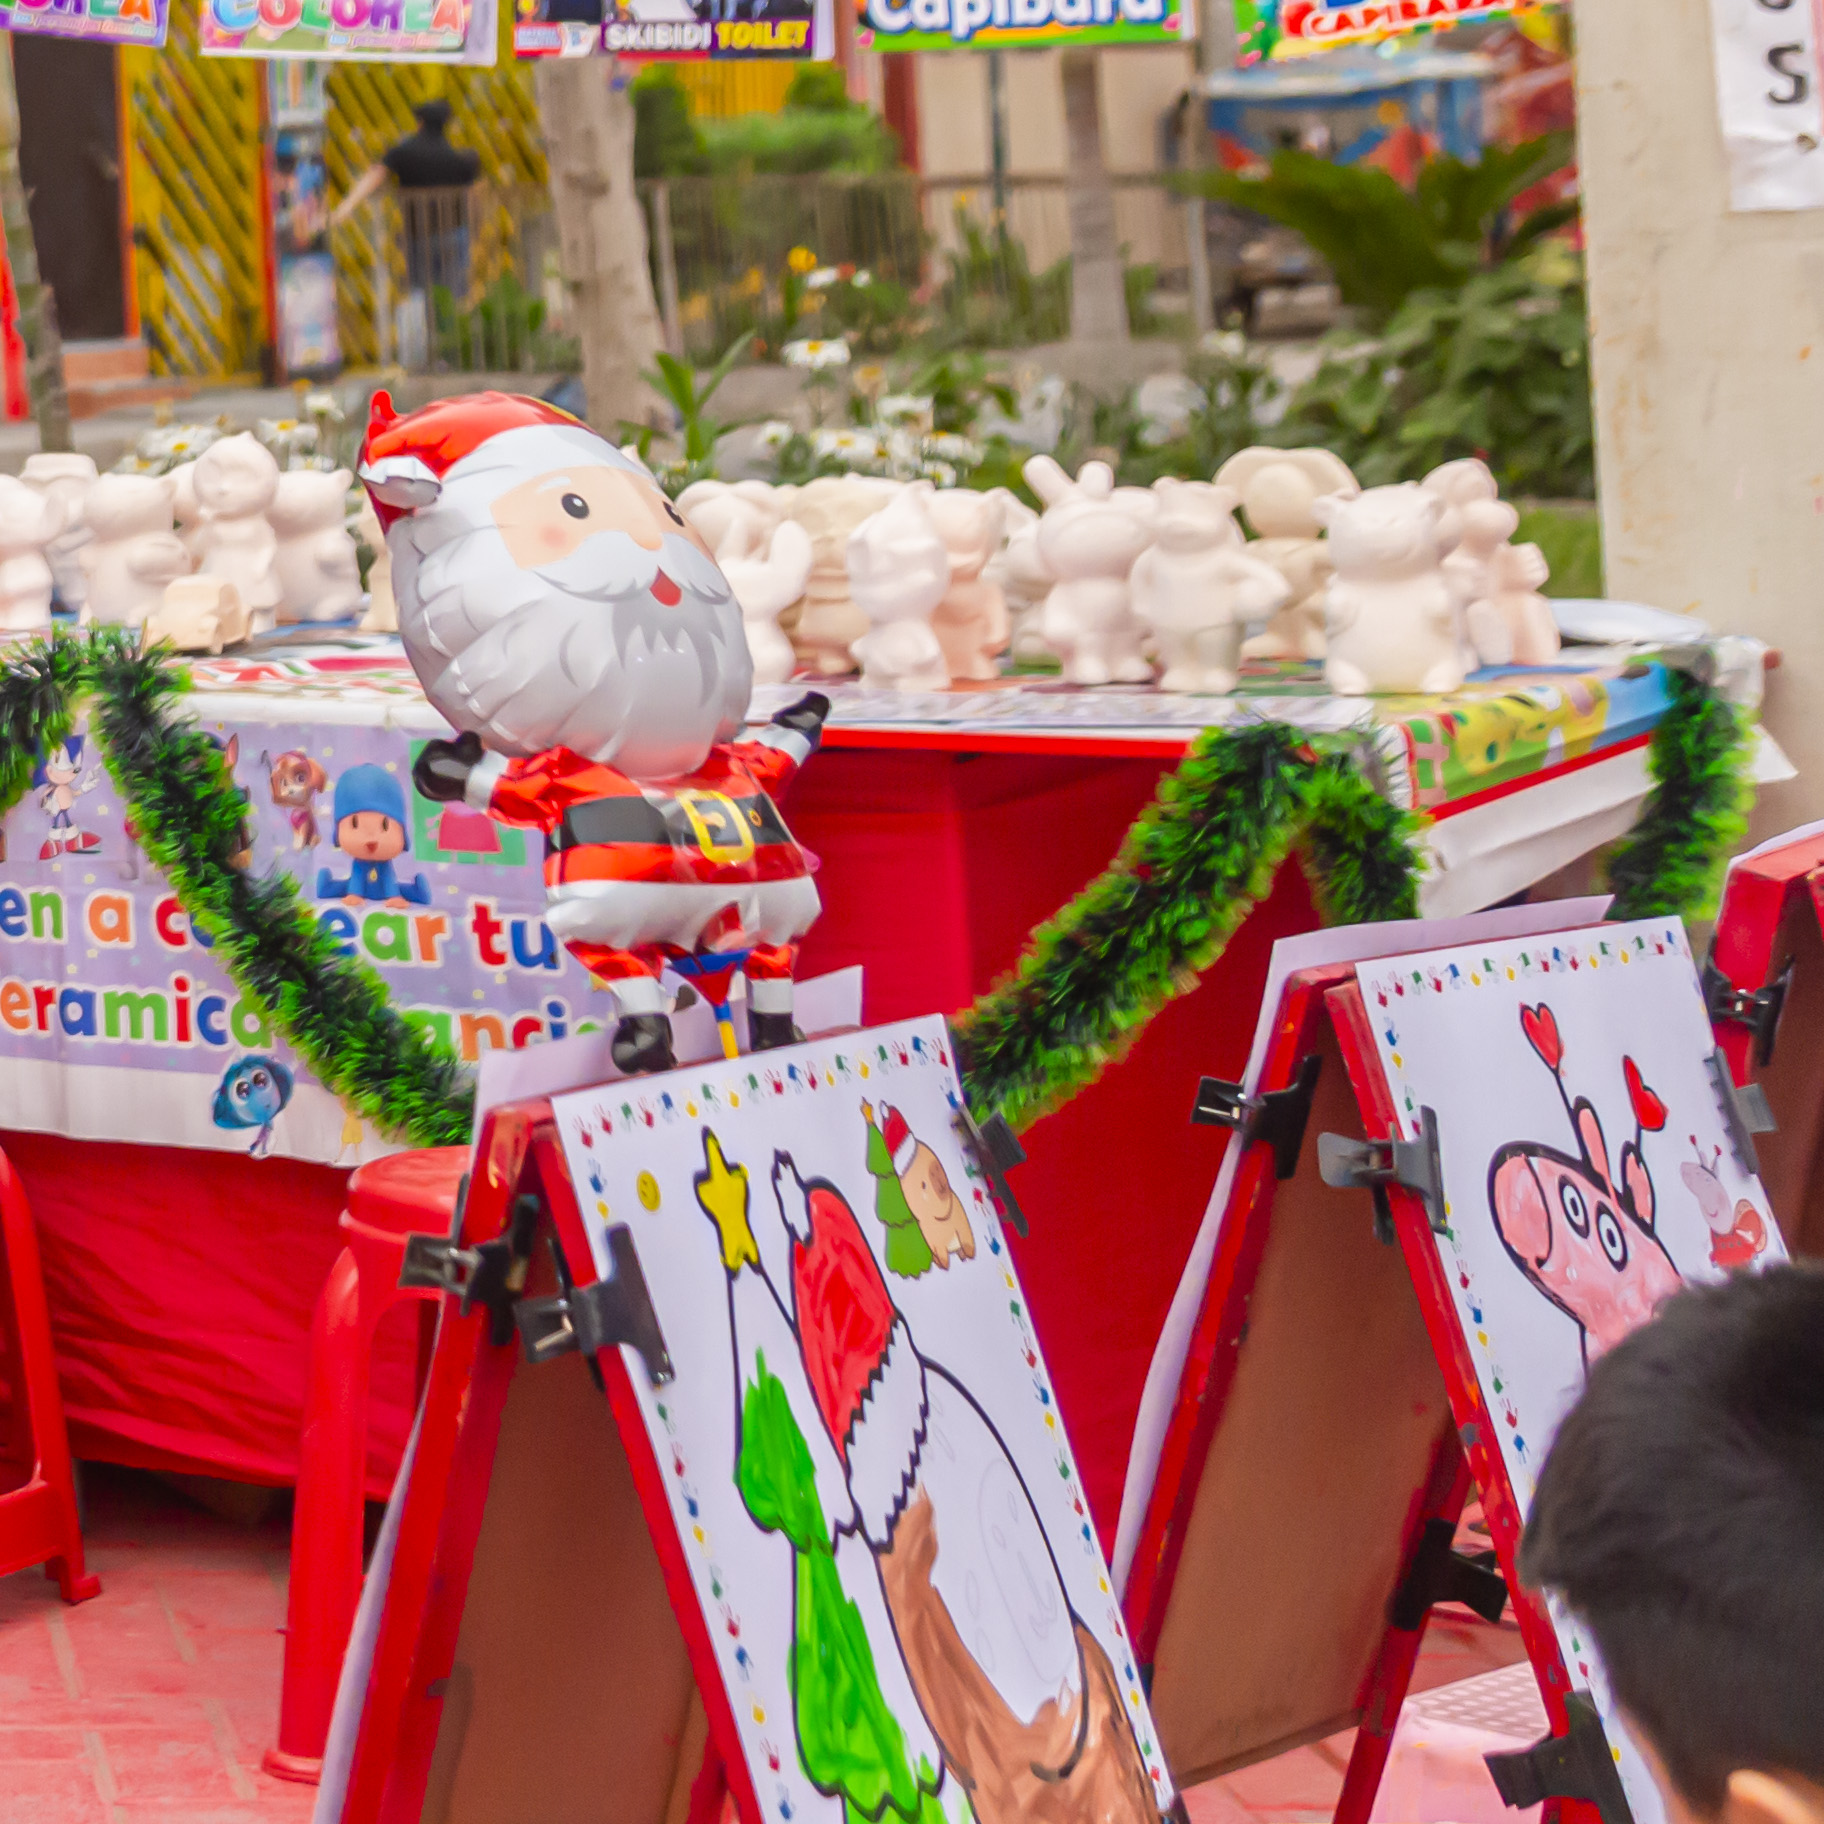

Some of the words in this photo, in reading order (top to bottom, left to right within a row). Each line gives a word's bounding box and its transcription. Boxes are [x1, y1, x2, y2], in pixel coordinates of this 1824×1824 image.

[605, 21, 711, 49] SKIBIDI
[715, 20, 810, 49] TOILET
[88, 894, 131, 943] a
[472, 902, 559, 970] tu
